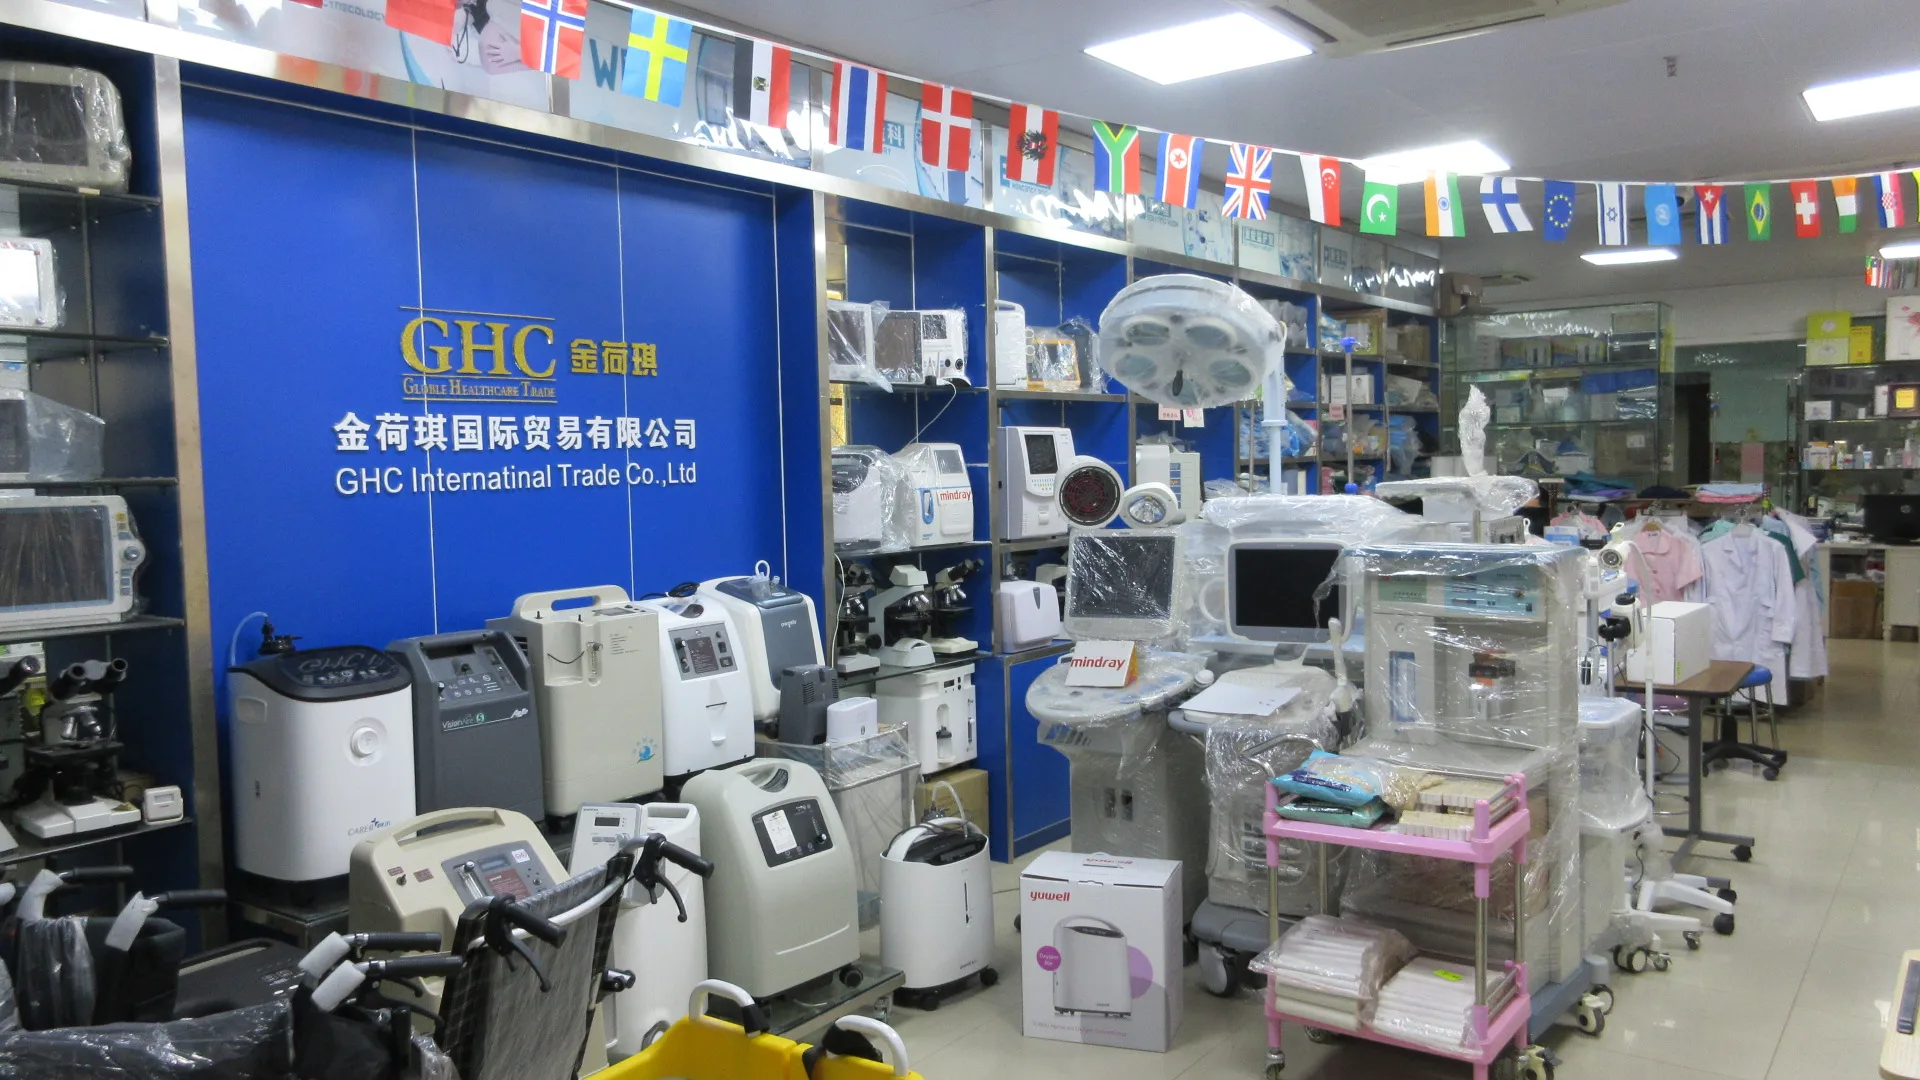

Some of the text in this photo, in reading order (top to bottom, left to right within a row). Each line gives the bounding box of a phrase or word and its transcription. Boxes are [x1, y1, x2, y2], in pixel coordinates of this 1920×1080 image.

[401, 317, 556, 378] GHC
[570, 338, 658, 377] 金荷琪
[449, 379, 519, 398] HEALTHCARE
[521, 381, 556, 398] TRADE
[333, 411, 697, 452] 金荷琪国际贸易有限公司
[335, 461, 697, 495] GHC Internatinal Trade Co.,Ltd
[940, 490, 971, 502] mindray
[1070, 657, 1126, 671] mindray
[1030, 891, 1071, 902] yuwell
